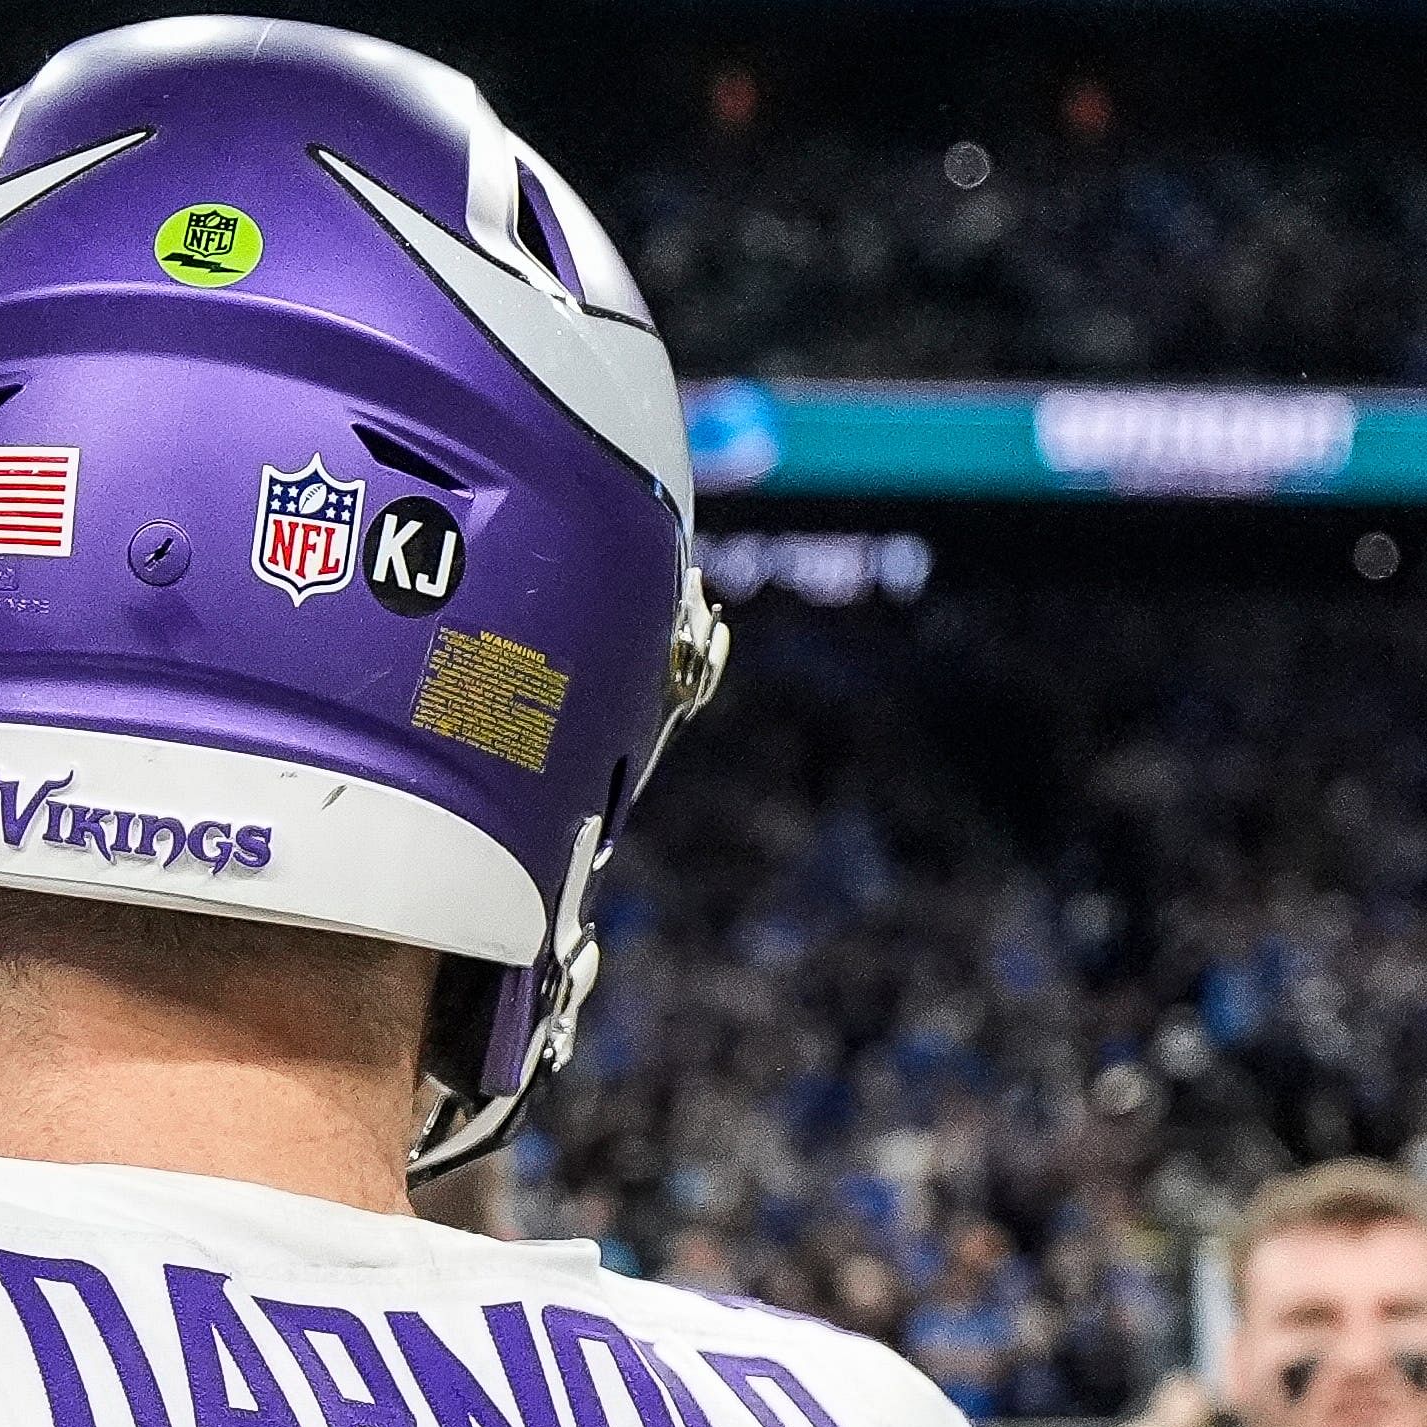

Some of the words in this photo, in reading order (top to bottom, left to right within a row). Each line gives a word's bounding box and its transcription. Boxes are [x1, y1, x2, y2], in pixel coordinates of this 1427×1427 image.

[188, 228, 228, 252] NFL
[267, 519, 341, 580] NFL
[372, 513, 458, 598] KJ
[479, 630, 547, 665] WARNING
